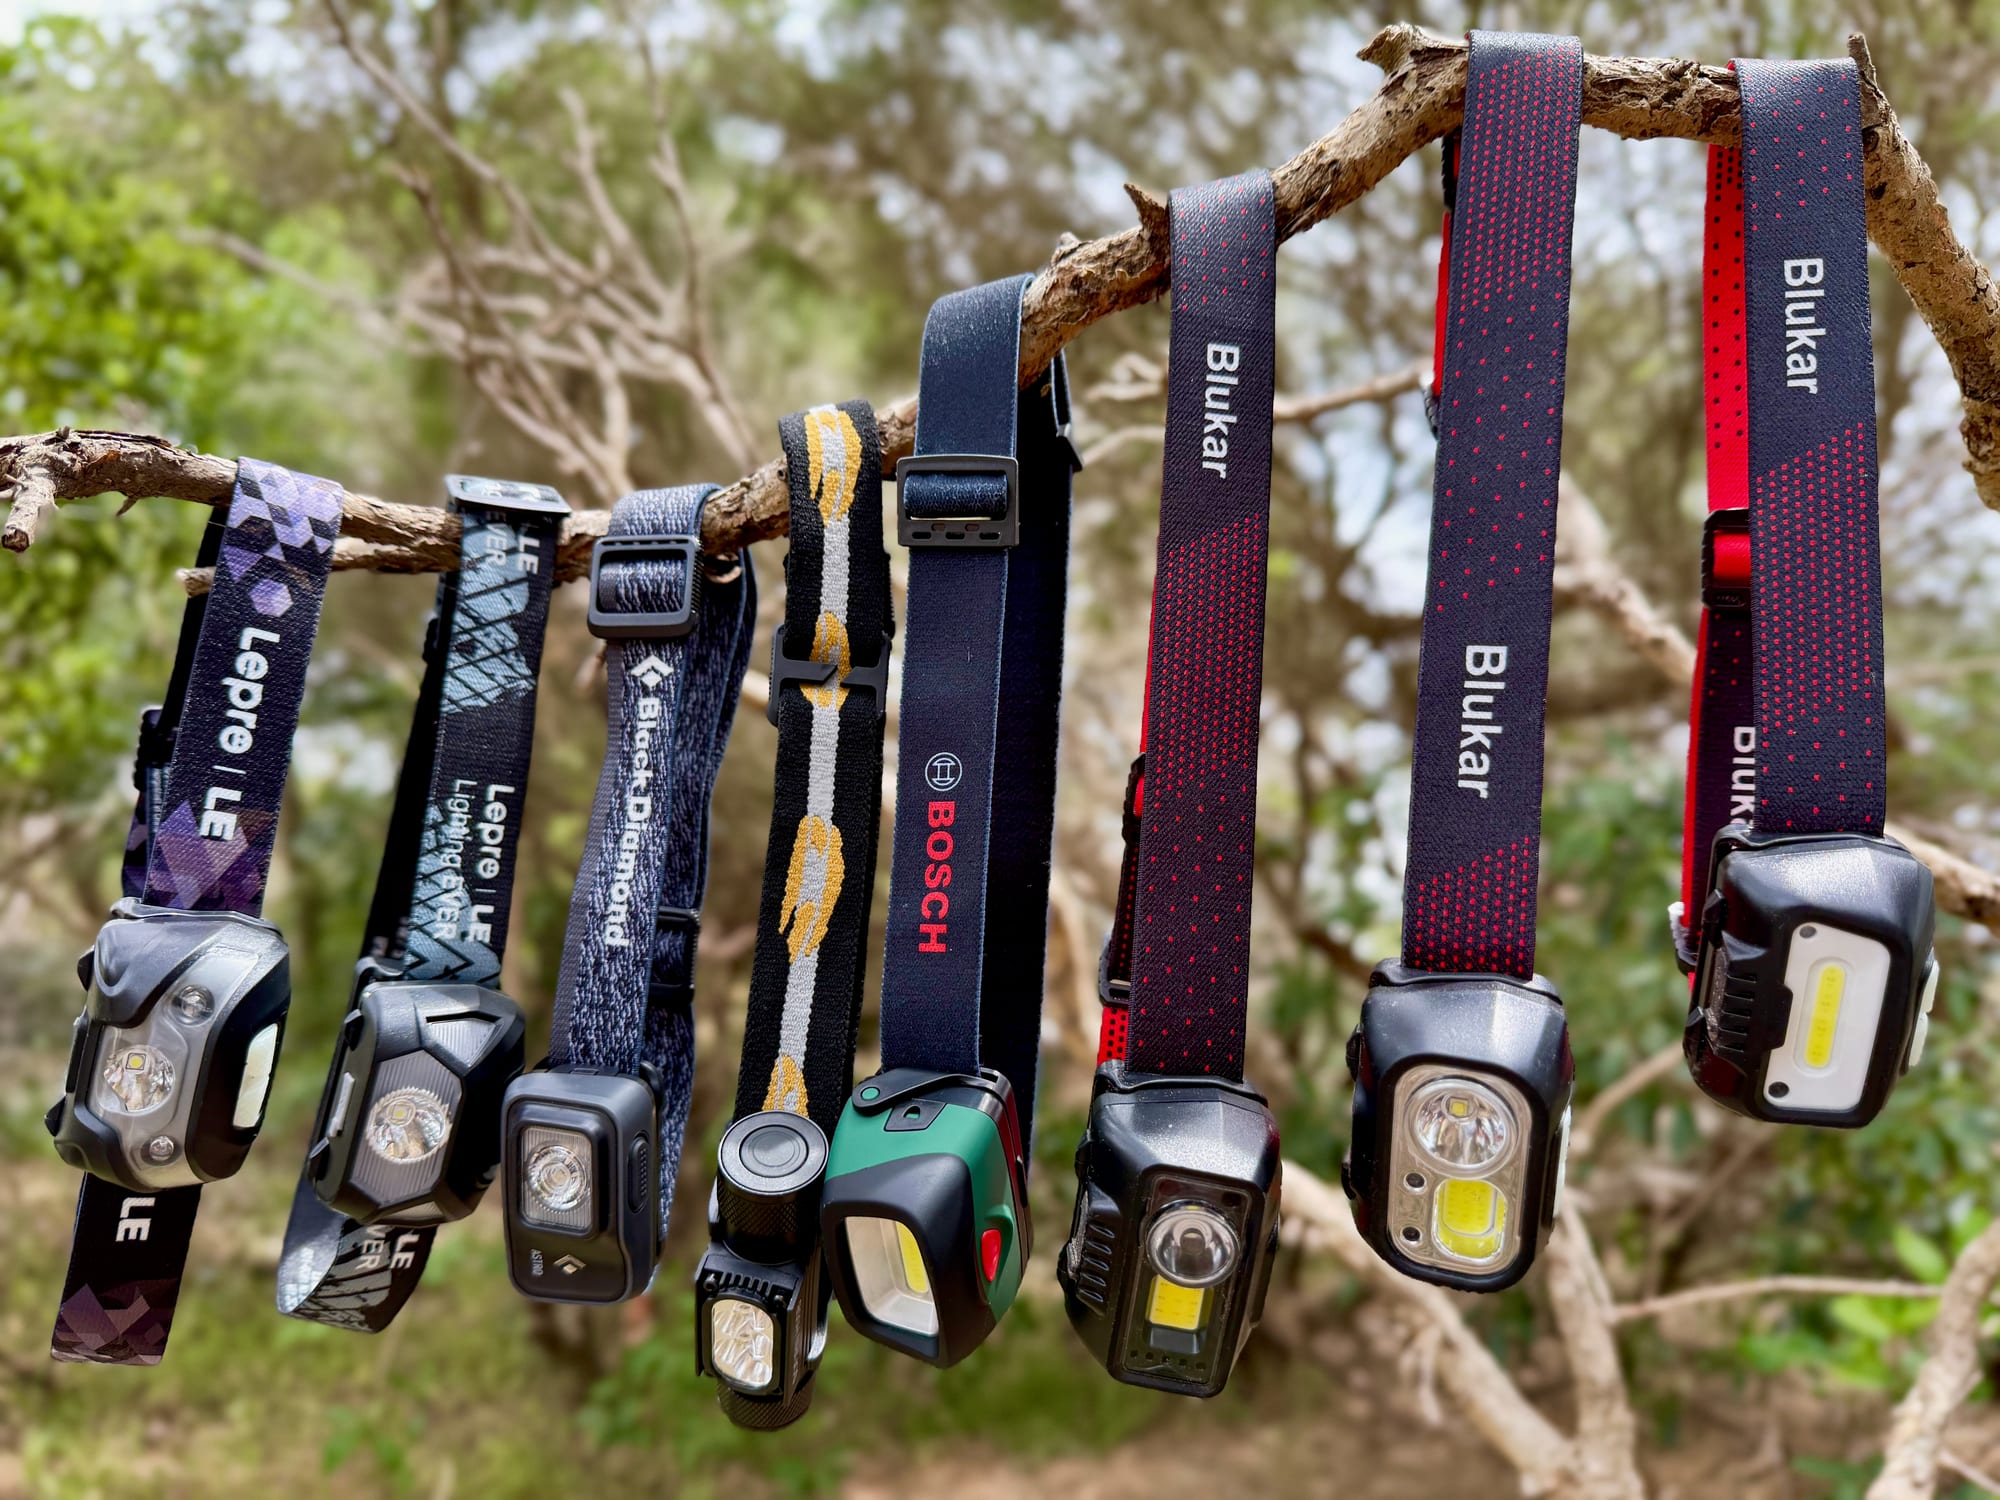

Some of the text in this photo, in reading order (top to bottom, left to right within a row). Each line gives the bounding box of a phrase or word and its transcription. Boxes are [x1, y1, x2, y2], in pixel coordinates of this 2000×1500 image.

[1784, 258, 1826, 395] Blukar
[1202, 343, 1240, 480] Blukar
[518, 535, 540, 575] LE
[1458, 645, 1508, 799] Blukar
[200, 786, 243, 841] LE
[439, 779, 478, 868] Lighting
[605, 697, 660, 947] Black Diamond
[918, 801, 956, 953] BOSCH
[468, 904, 495, 944] LE
[115, 1197, 156, 1242] LE
[390, 1233, 420, 1270] LE
